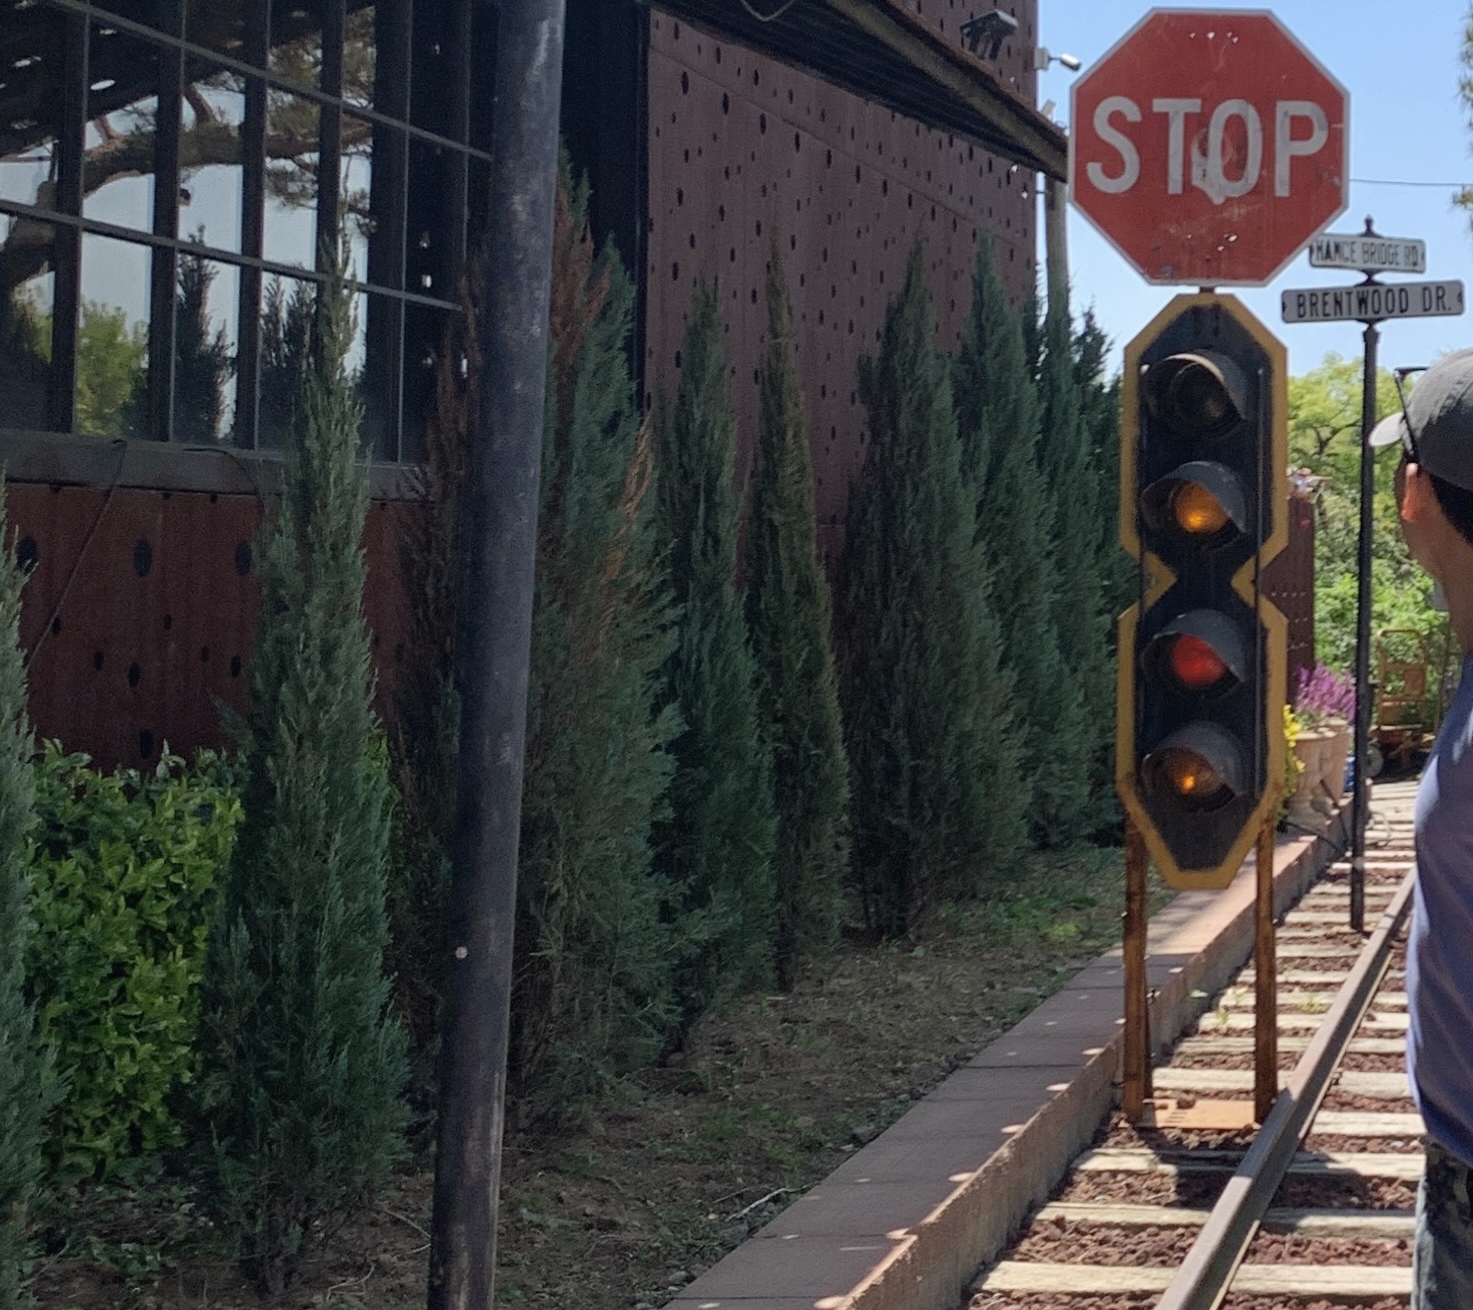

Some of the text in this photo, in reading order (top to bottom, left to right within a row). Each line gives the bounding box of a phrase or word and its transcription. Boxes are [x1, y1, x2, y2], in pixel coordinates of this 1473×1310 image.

[1086, 95, 1329, 199] STOP
[1361, 241, 1401, 266] BRIDGE
[1296, 285, 1453, 319] BRENTWOOD DR.
